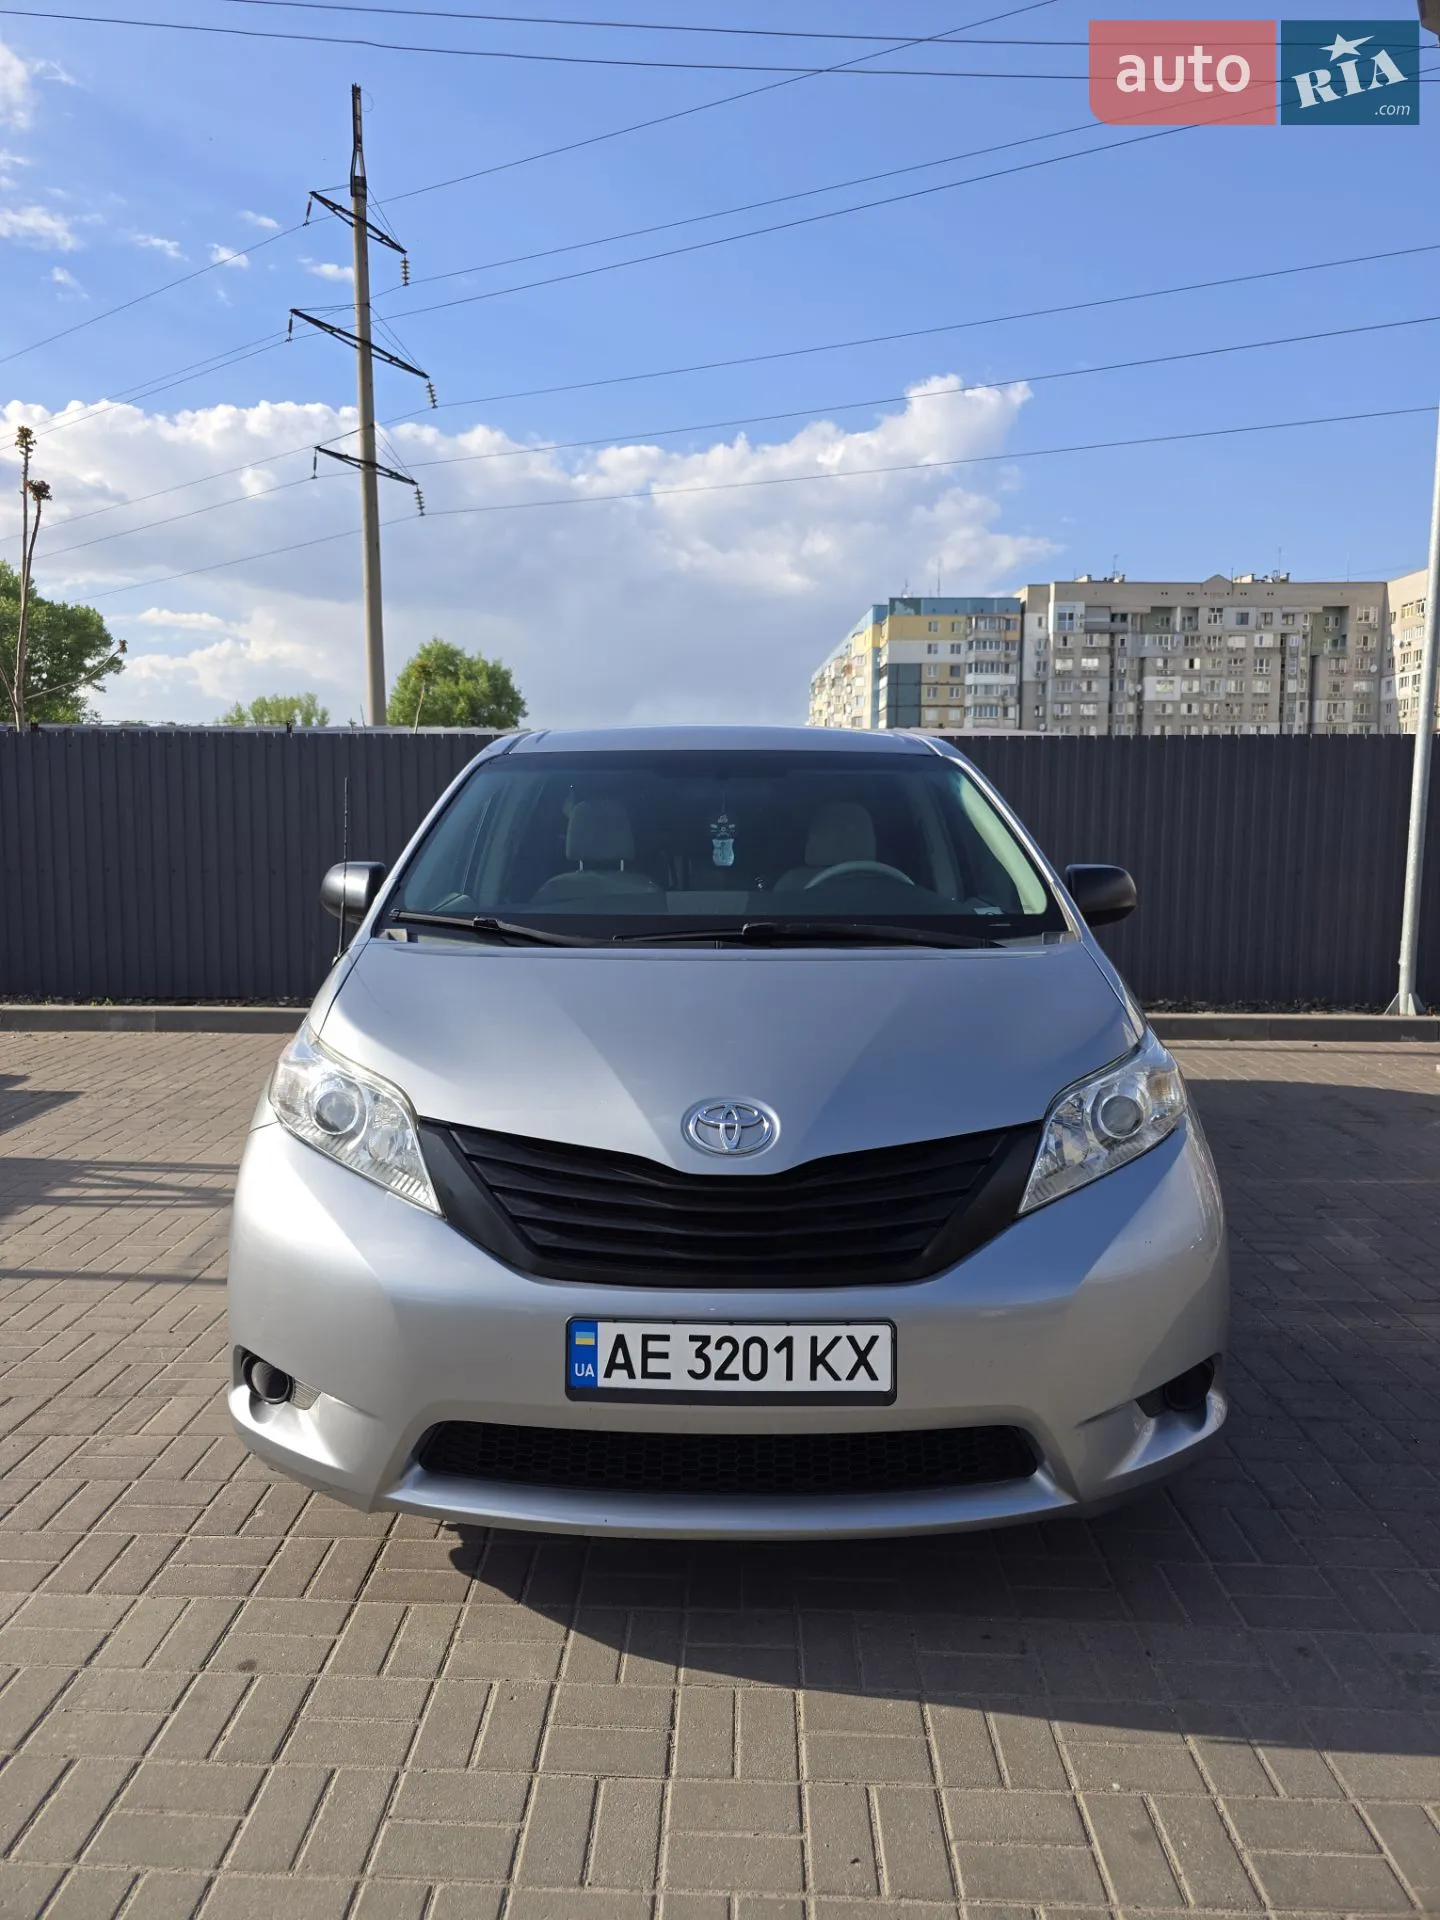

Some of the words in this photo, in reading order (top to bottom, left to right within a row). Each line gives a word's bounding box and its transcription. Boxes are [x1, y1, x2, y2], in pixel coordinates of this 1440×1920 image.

[575, 1363, 595, 1377] UA
[603, 1333, 671, 1379] AE
[687, 1335, 793, 1382] 3201
[810, 1335, 880, 1382] KX
